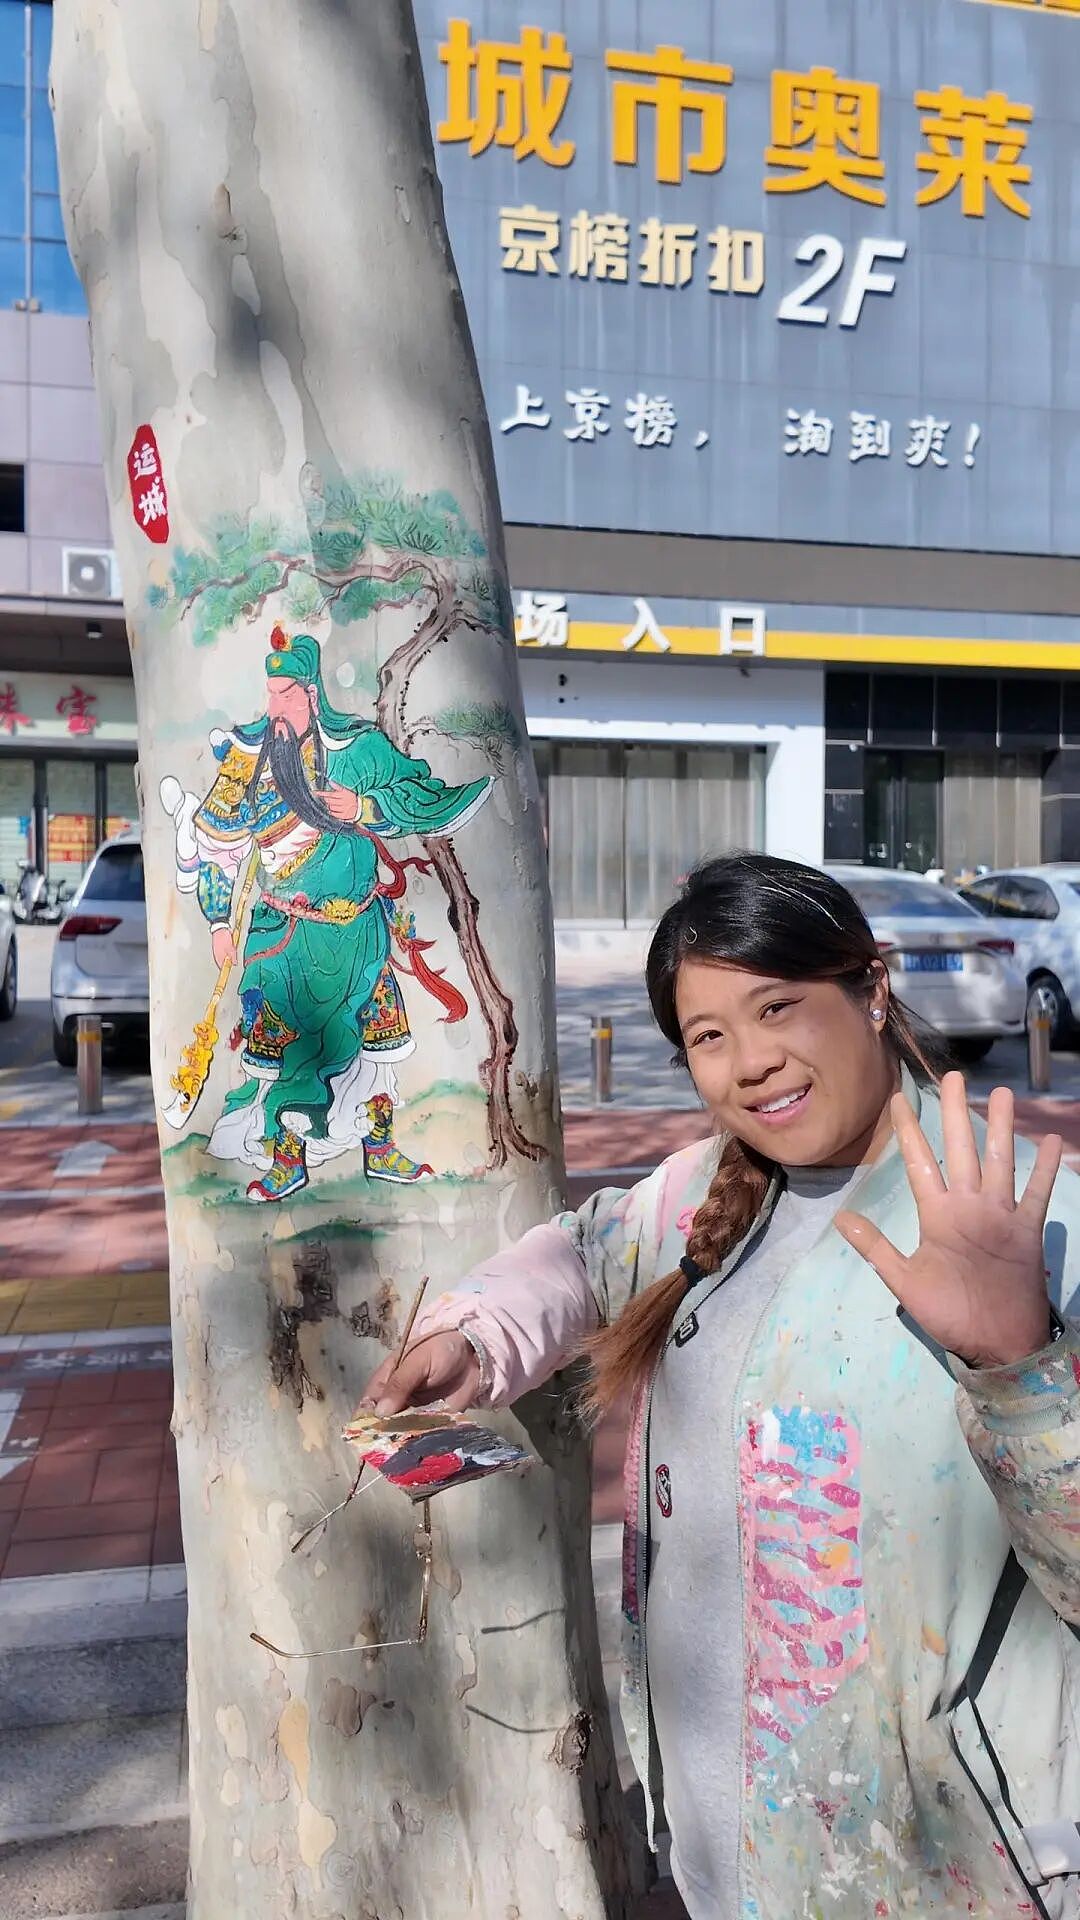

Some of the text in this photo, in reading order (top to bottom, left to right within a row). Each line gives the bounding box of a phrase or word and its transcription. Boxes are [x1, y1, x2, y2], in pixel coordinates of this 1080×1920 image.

[437, 18, 1034, 219] 城市奥莱
[499, 204, 908, 329] 京榜折扣 2F
[133, 443, 168, 526] 运城
